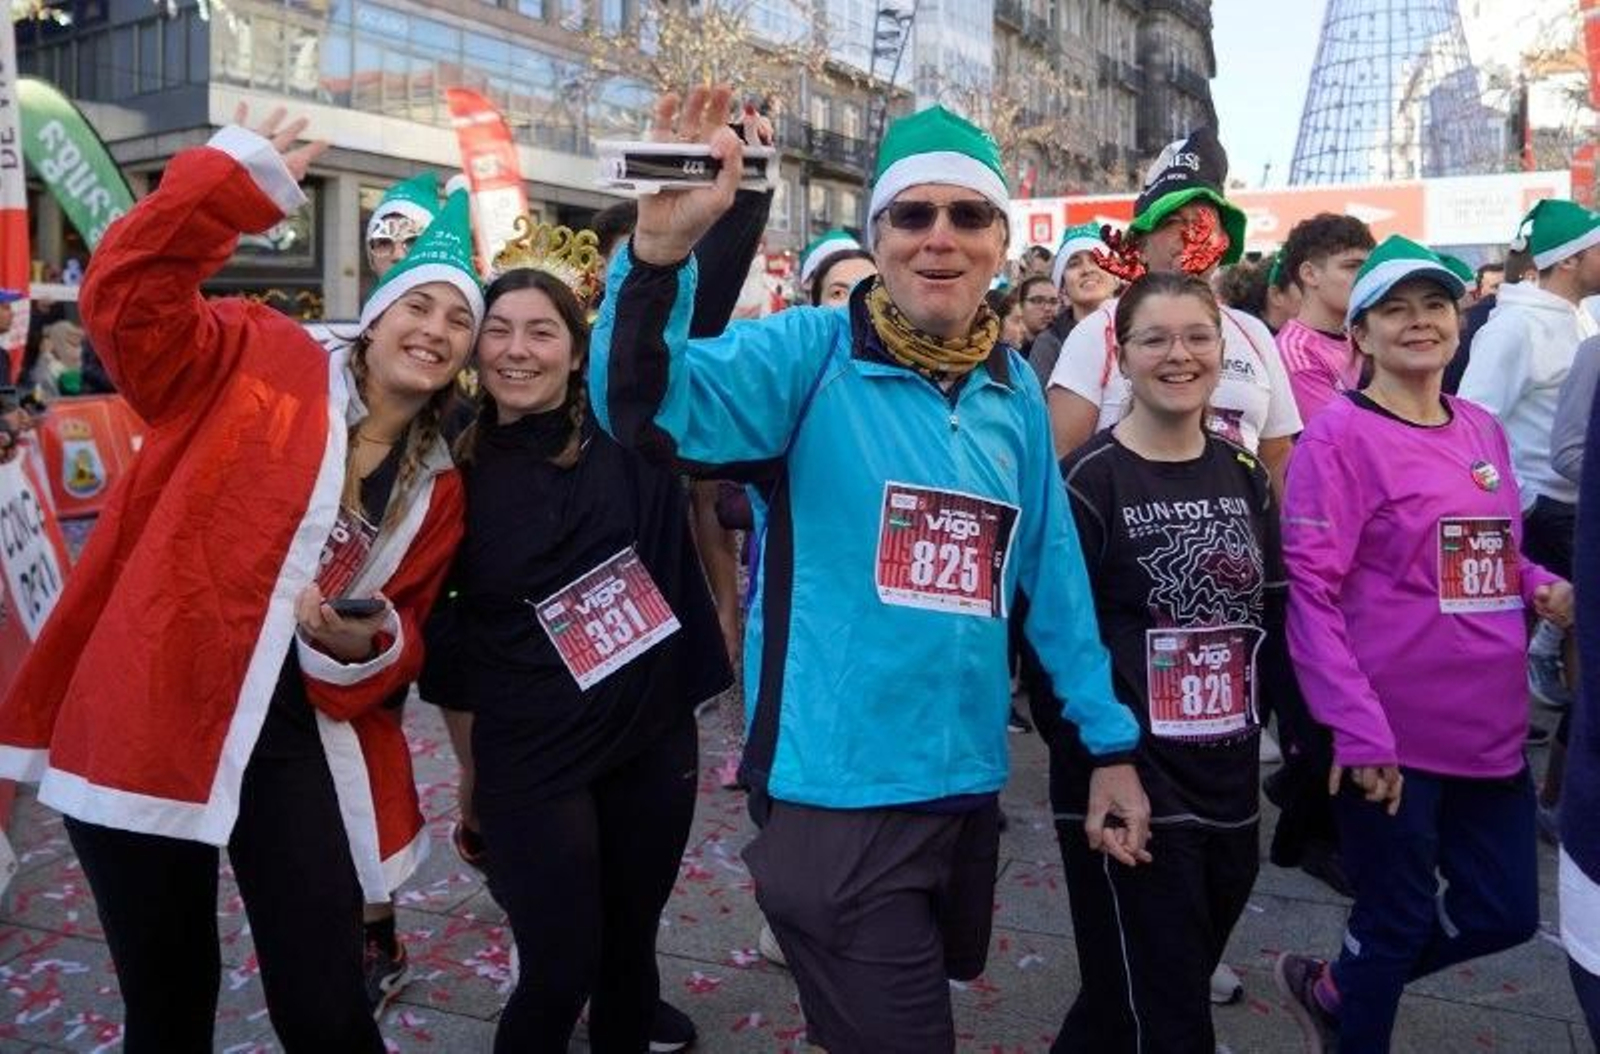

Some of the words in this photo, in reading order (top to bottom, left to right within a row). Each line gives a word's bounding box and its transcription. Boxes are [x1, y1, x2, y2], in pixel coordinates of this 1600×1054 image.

[925, 509, 981, 541] vigo
[910, 541, 980, 592] 825
[1462, 556, 1507, 595] 824
[574, 579, 627, 615] vigo
[585, 598, 649, 655] 331
[1187, 645, 1232, 671] vigo
[1181, 672, 1232, 717] 826
